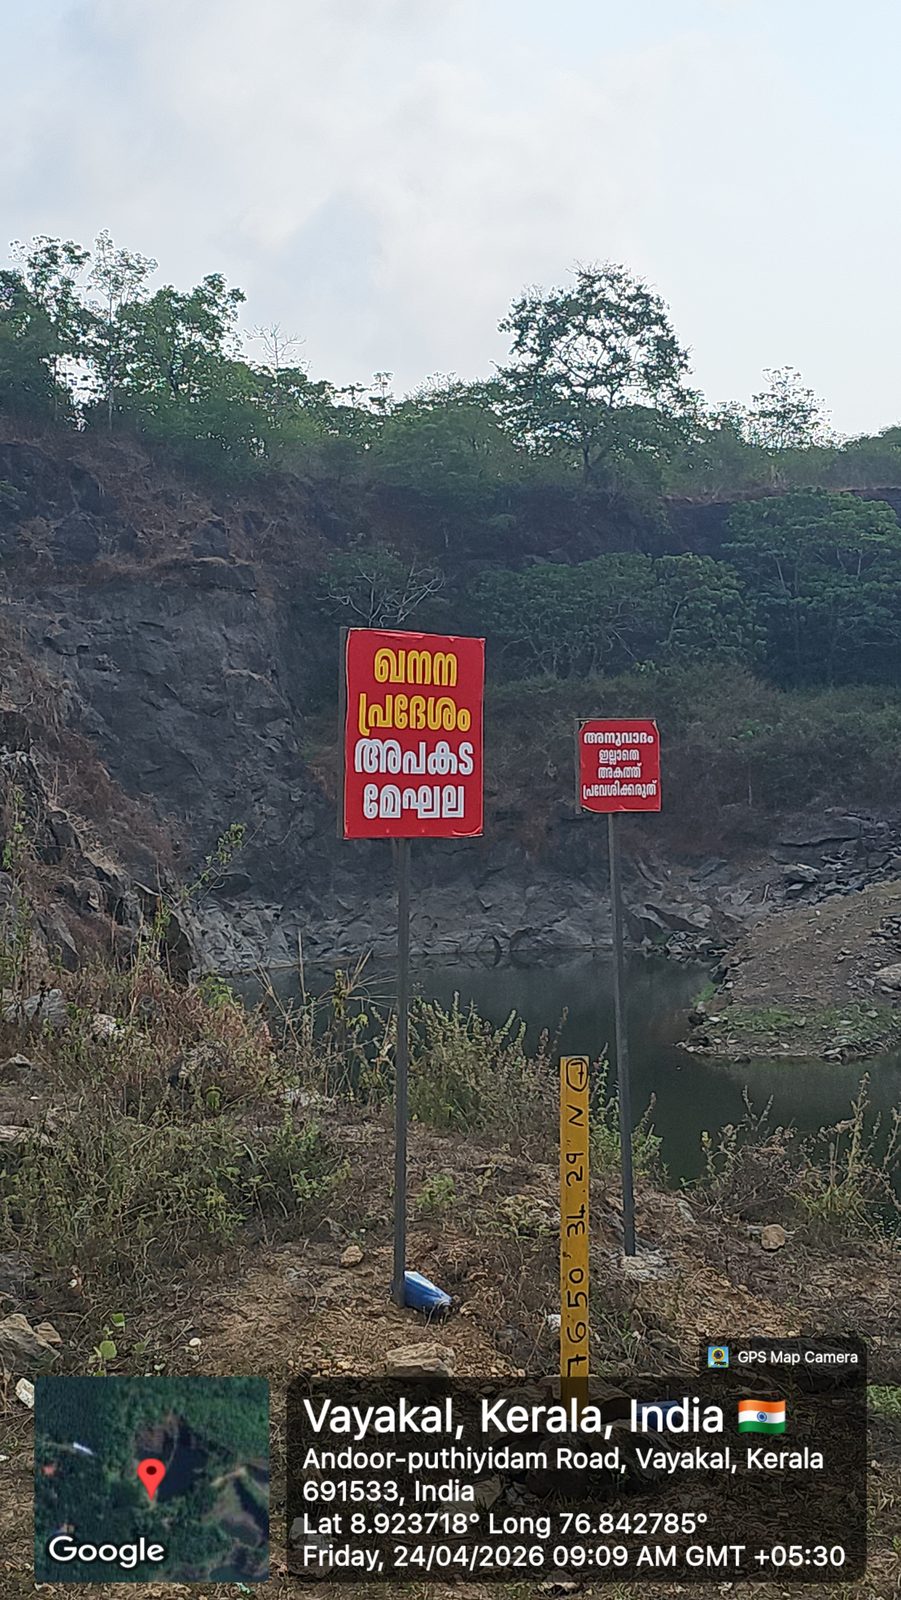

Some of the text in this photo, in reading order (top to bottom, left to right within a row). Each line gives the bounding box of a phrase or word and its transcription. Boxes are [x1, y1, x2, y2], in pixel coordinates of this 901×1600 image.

[374, 648, 457, 686] ഖനന
[359, 693, 471, 736] പ്രദേശം
[583, 732, 654, 746] അനുവാദം
[354, 738, 473, 775] അപകട
[598, 749, 640, 765] ഇല്ലാതെ
[597, 762, 642, 778] അകത്ത്
[582, 780, 657, 799] പ്രവേശിക്കരുത്
